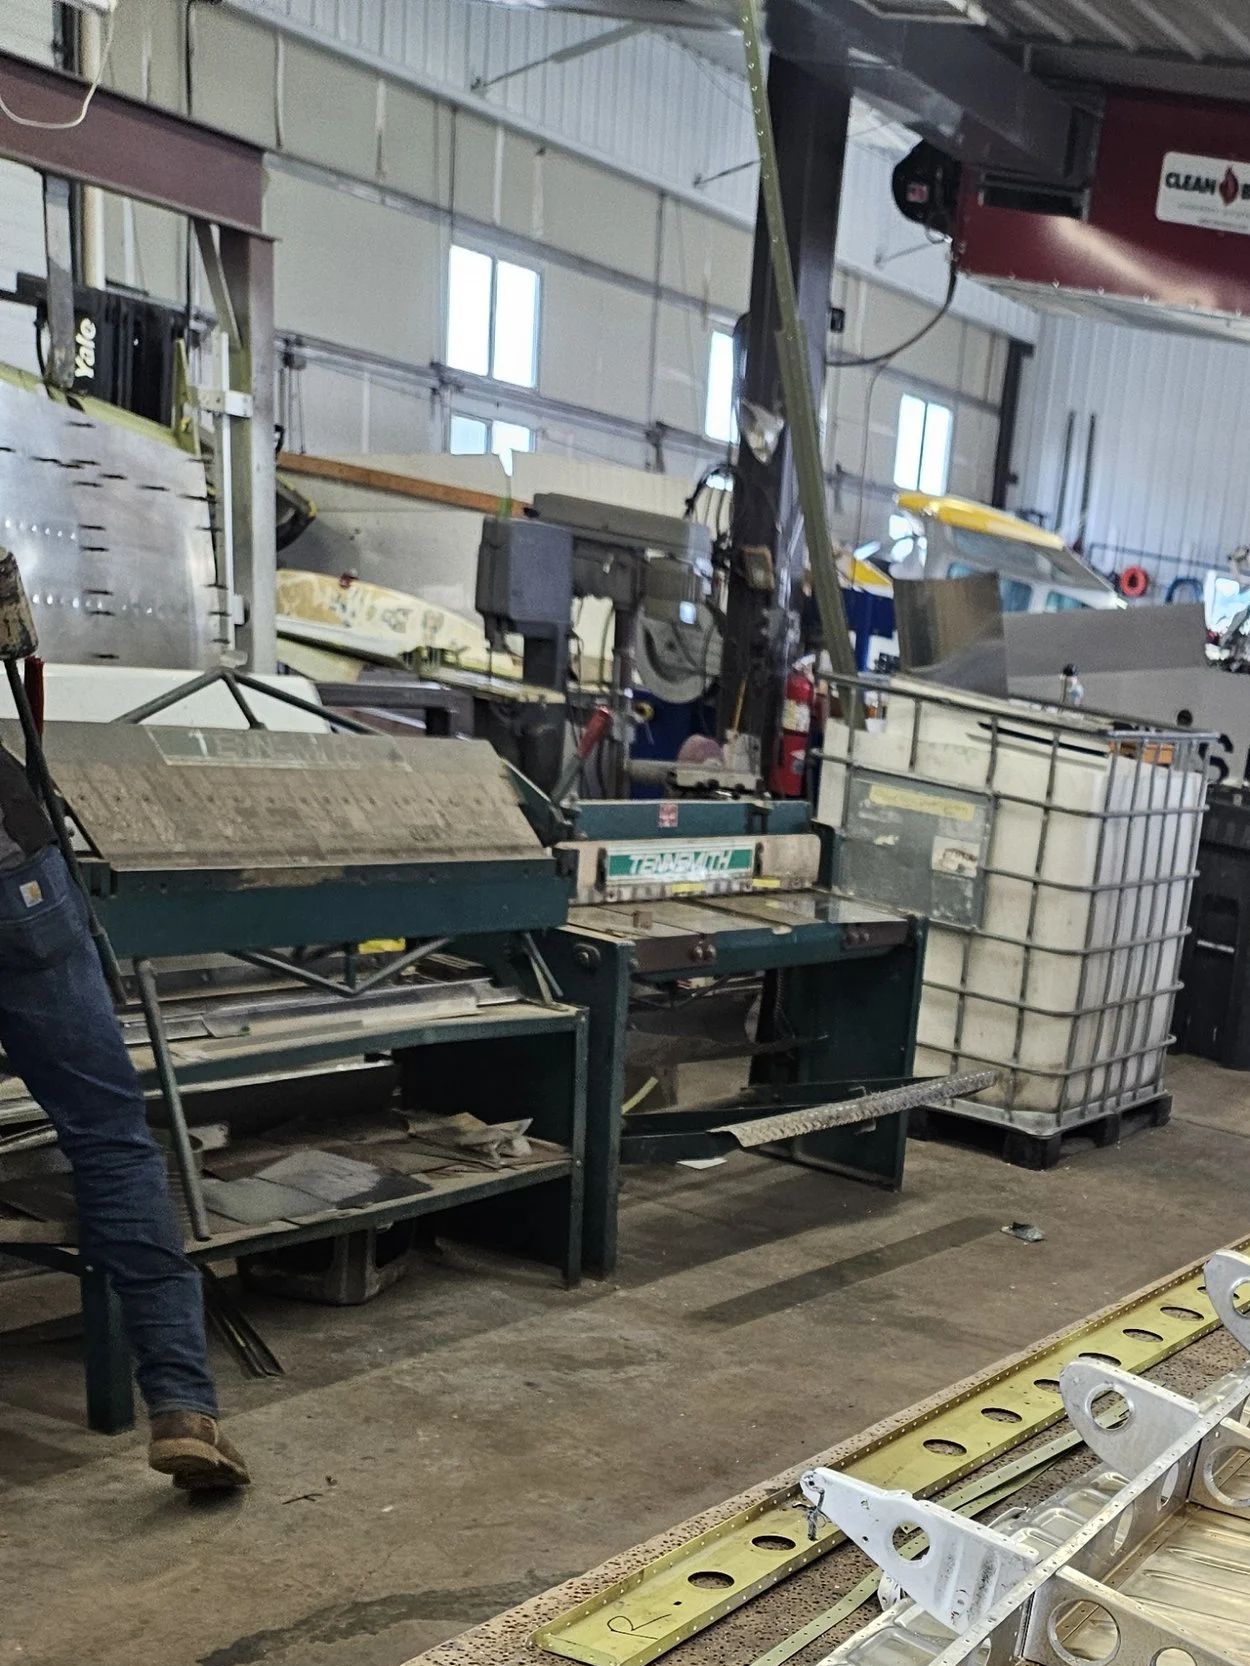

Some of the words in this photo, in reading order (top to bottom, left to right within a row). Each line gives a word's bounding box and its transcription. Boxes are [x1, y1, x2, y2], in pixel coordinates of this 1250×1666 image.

[1165, 171, 1217, 195] CLEAN
[74, 317, 97, 379] Yale
[628, 850, 733, 874] TENNSMITH
